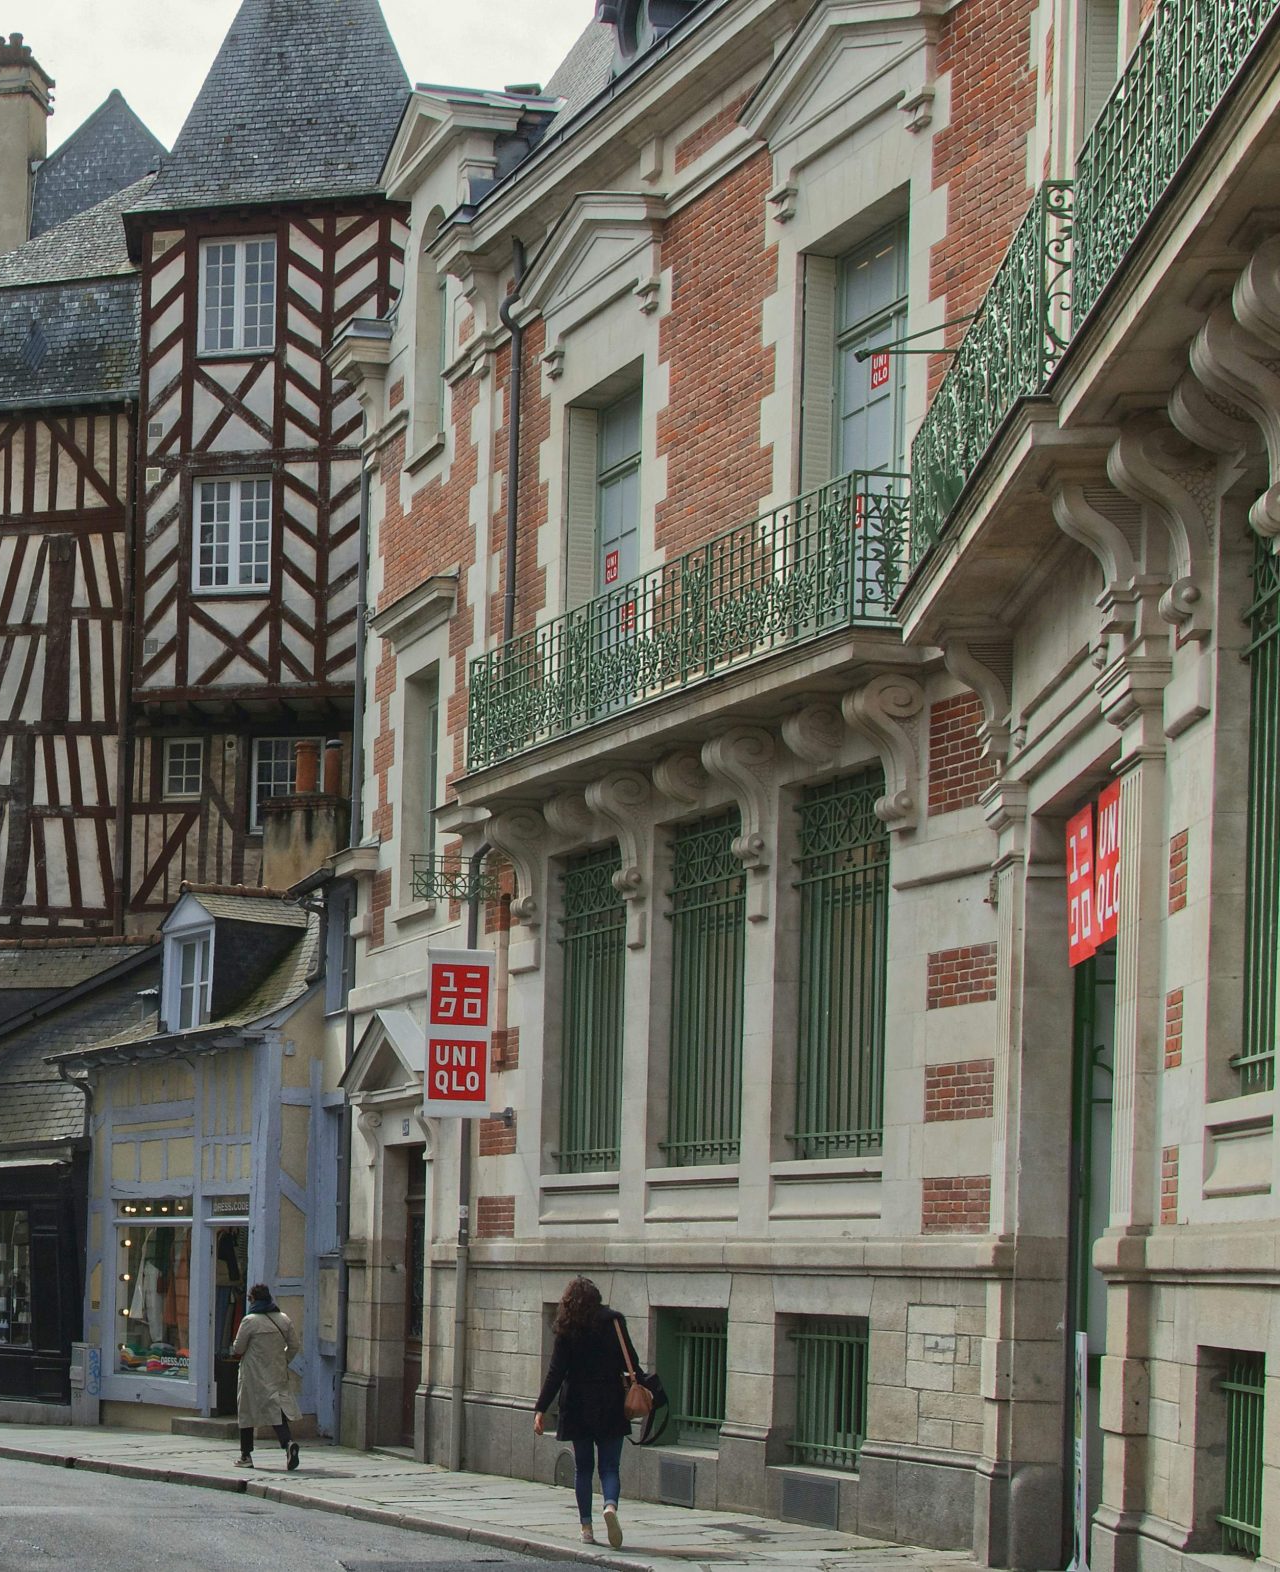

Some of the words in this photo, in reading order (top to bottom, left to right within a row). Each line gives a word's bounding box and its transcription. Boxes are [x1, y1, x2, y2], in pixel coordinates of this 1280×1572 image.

[873, 353, 887, 370] UNI
[872, 368, 888, 386] QLO
[606, 554, 617, 569] UNI
[606, 566, 617, 582] QLO
[1096, 861, 1120, 932] QLO
[439, 971, 482, 993] ユニ
[437, 997, 482, 1019] クロ
[435, 1045, 476, 1067] UNI
[434, 1070, 480, 1094] QLO
[160, 1356, 190, 1367] DRESS.COD
